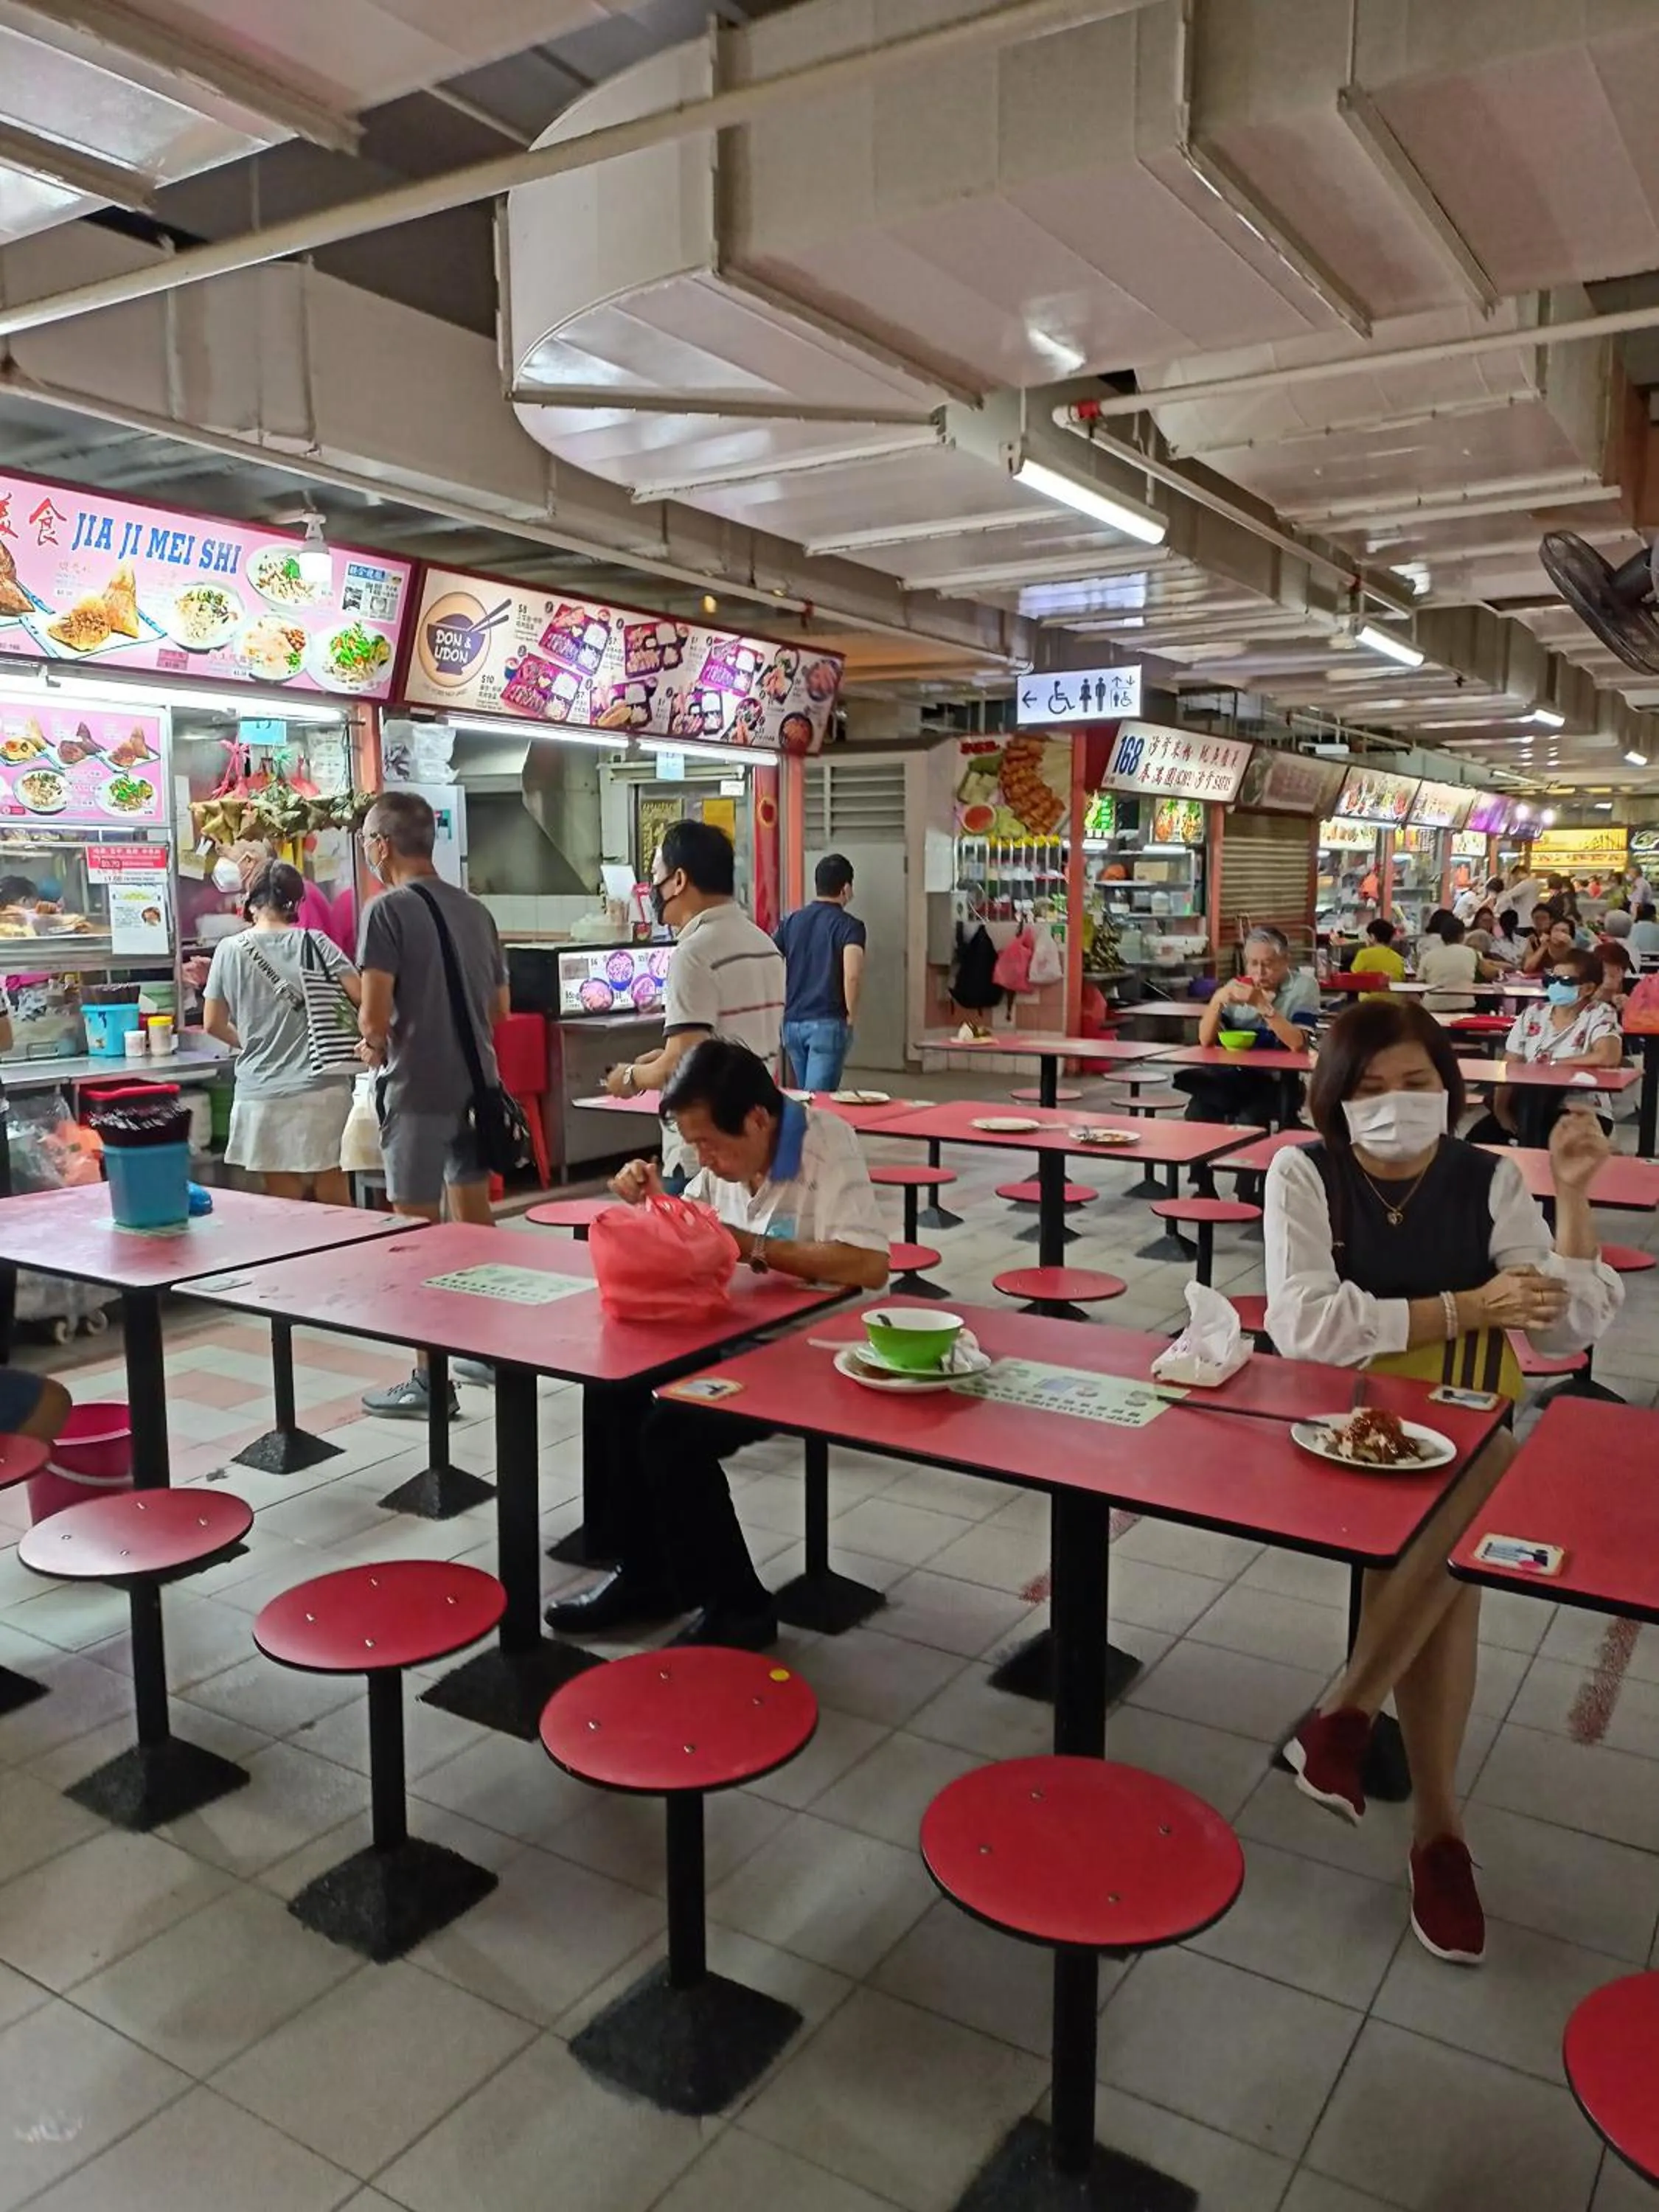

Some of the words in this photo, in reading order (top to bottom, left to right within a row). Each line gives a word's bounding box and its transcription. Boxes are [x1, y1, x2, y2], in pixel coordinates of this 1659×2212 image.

[72, 512, 114, 551] JIA
[118, 521, 143, 560] JI
[146, 527, 196, 566] MEI
[198, 538, 243, 574] SHI
[435, 629, 463, 647] DON
[464, 637, 472, 649] &
[434, 645, 469, 664] UDON
[1113, 735, 1145, 776] 168
